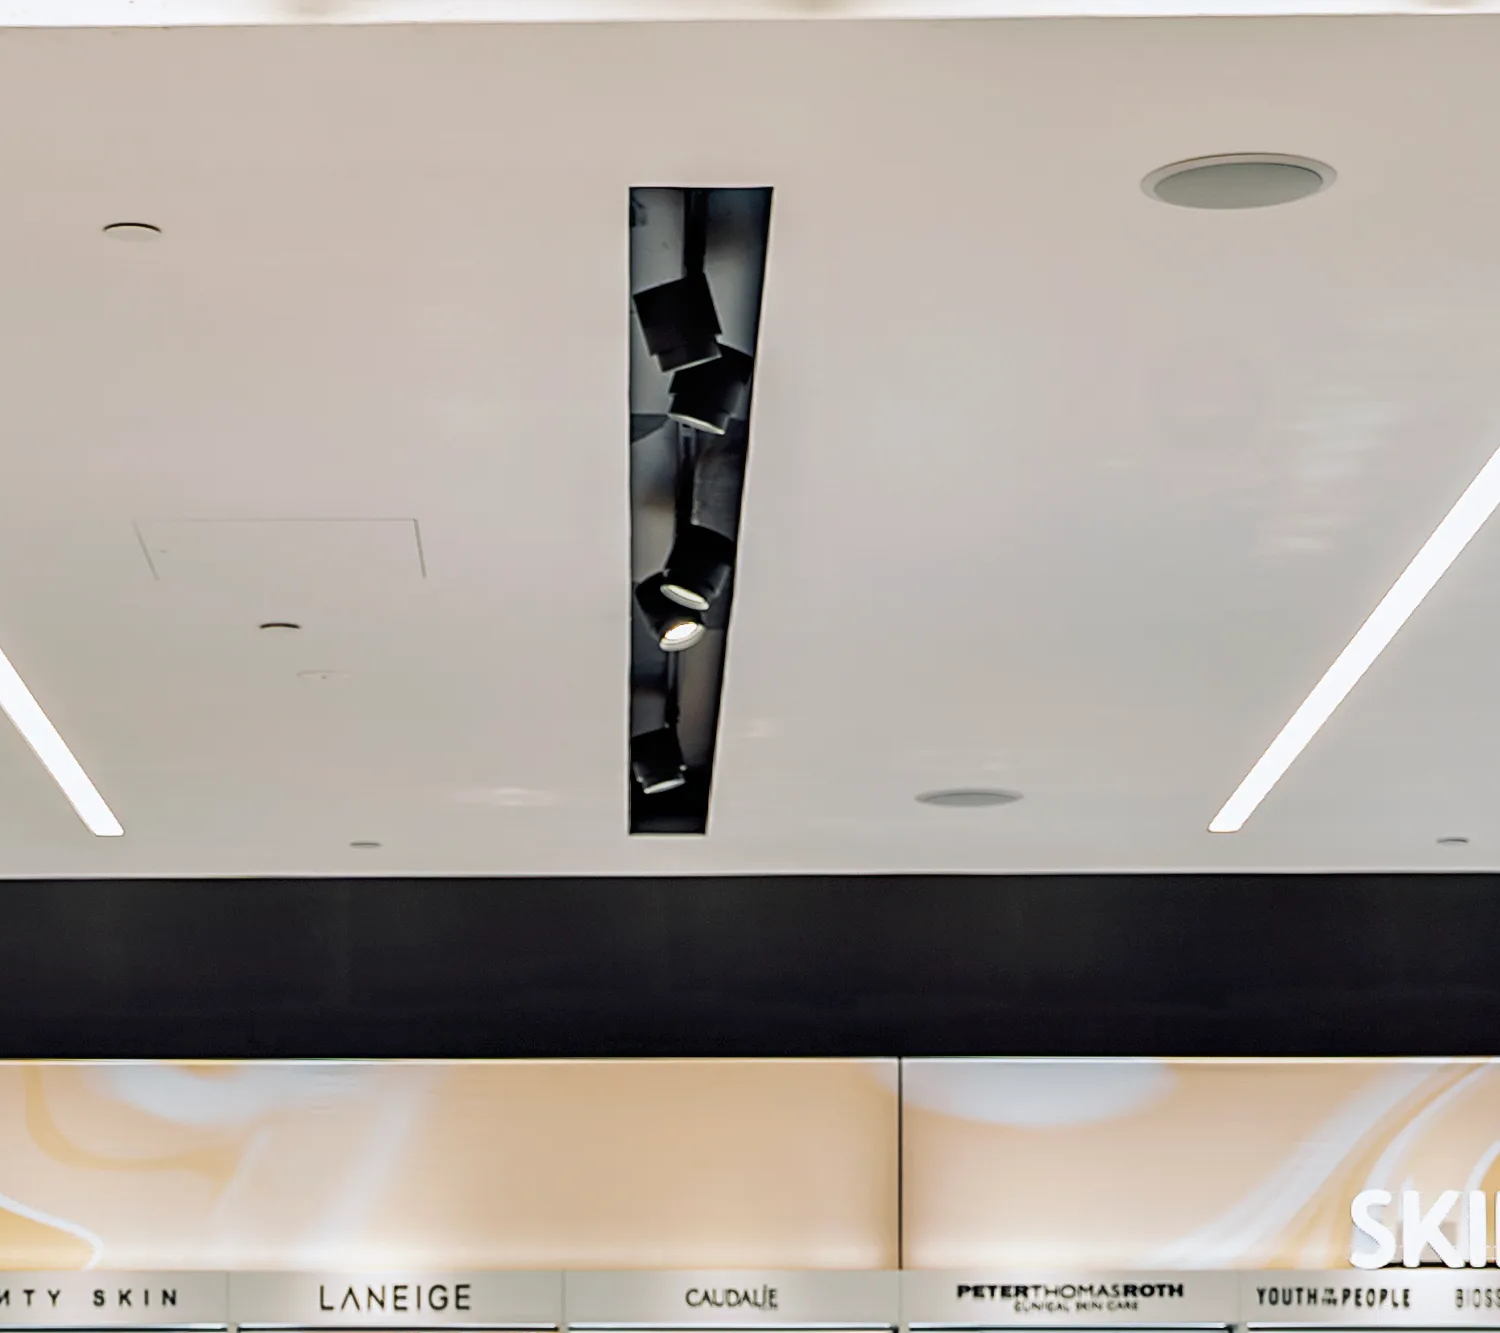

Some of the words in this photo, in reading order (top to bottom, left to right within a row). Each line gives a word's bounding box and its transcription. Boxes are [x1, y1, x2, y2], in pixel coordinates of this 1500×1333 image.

[92, 1289, 179, 1307] SKIN
[319, 1284, 472, 1311] LANEIGE
[956, 1283, 1184, 1299] PETERTHOMASROTH
[1256, 1287, 1318, 1307] YOUTH
[1342, 1287, 1411, 1307] PEOPLE
[1106, 1301, 1139, 1312] CARE
